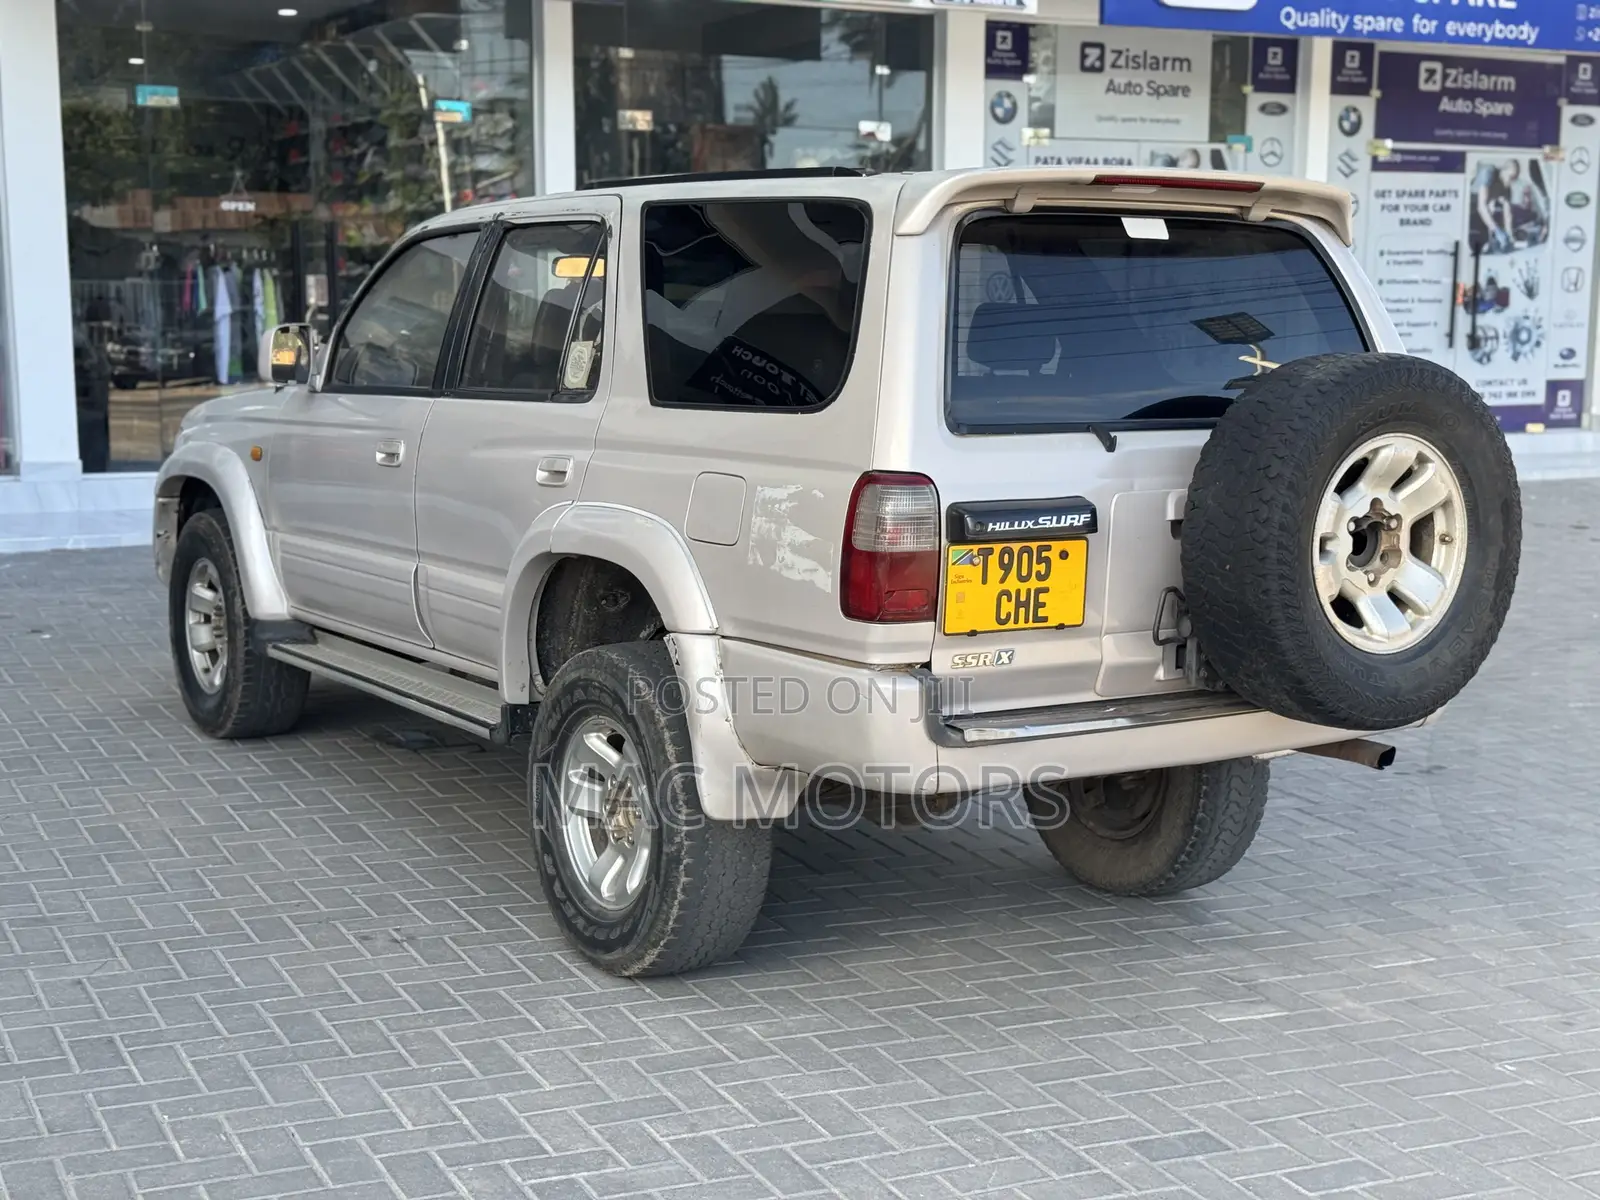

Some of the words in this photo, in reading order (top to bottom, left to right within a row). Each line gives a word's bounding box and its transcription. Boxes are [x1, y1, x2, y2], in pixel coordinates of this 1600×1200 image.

[1280, 6, 1349, 31] Quality
[1353, 15, 1405, 35] spare
[1412, 13, 1438, 35] for
[1445, 18, 1540, 45] everybody
[1110, 48, 1192, 73] Zislarm
[1105, 79, 1144, 96] Auto
[1146, 80, 1191, 100] Spare
[1444, 67, 1516, 92] Zislarm
[1439, 96, 1473, 114] Auto
[1474, 97, 1514, 117] Spare
[1034, 156, 1062, 165] PATA
[1374, 189, 1393, 199] GET
[1395, 189, 1426, 199] SPARE
[1429, 189, 1459, 199] PARTS
[1380, 203, 1400, 213] FOR
[1403, 203, 1429, 213] YOUR
[1432, 203, 1452, 213] CAR
[1399, 217, 1433, 227] BRAND
[994, 586, 1051, 627] CHE
